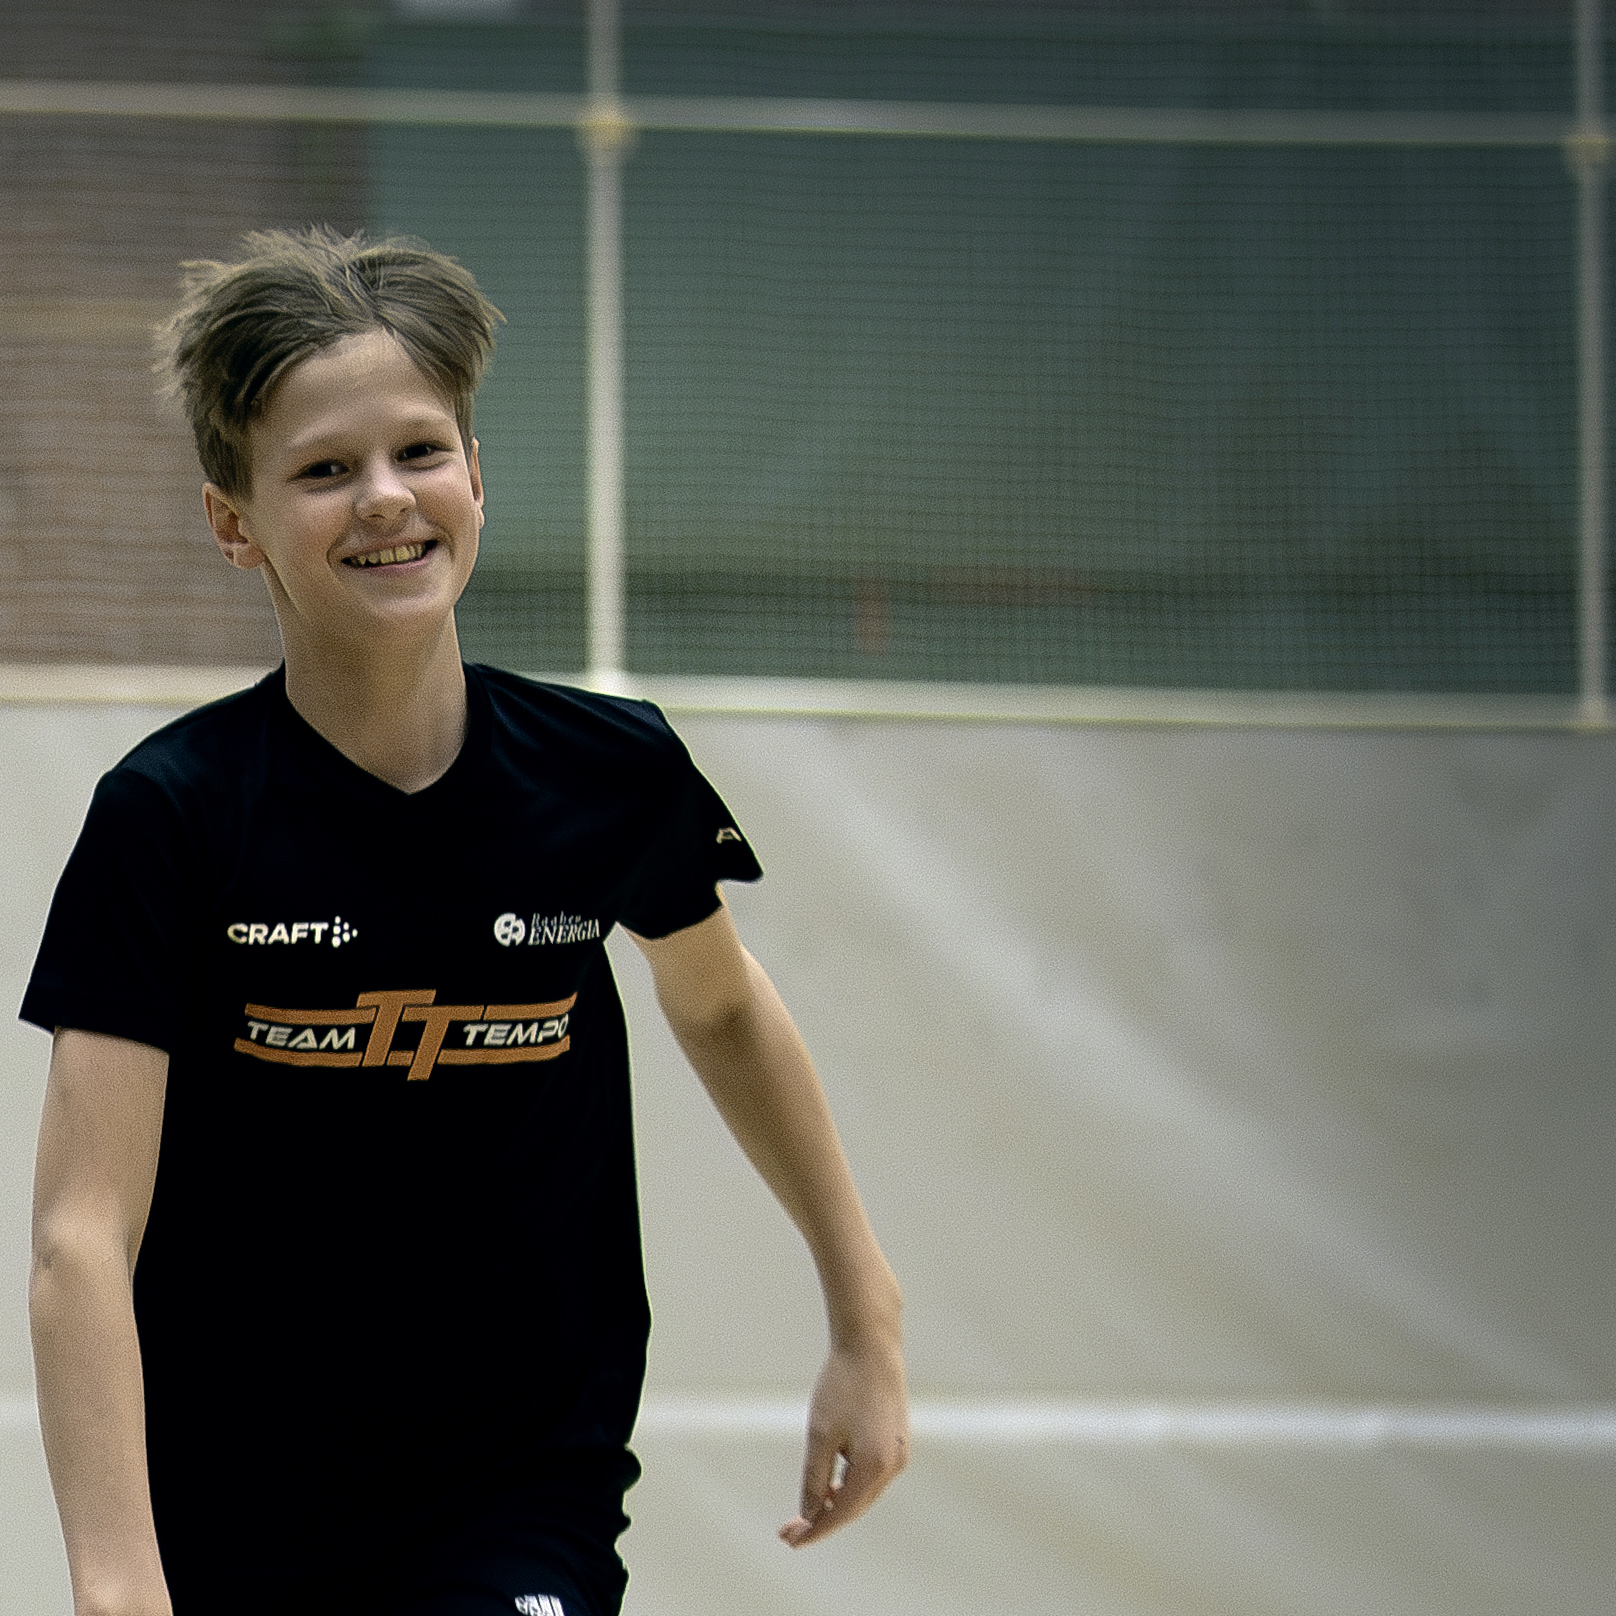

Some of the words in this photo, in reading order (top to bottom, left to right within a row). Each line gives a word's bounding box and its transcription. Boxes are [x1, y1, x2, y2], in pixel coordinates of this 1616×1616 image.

[227, 922, 329, 945] CRAFT
[247, 1021, 356, 1050] TEAM
[463, 1013, 569, 1046] TEMPO
